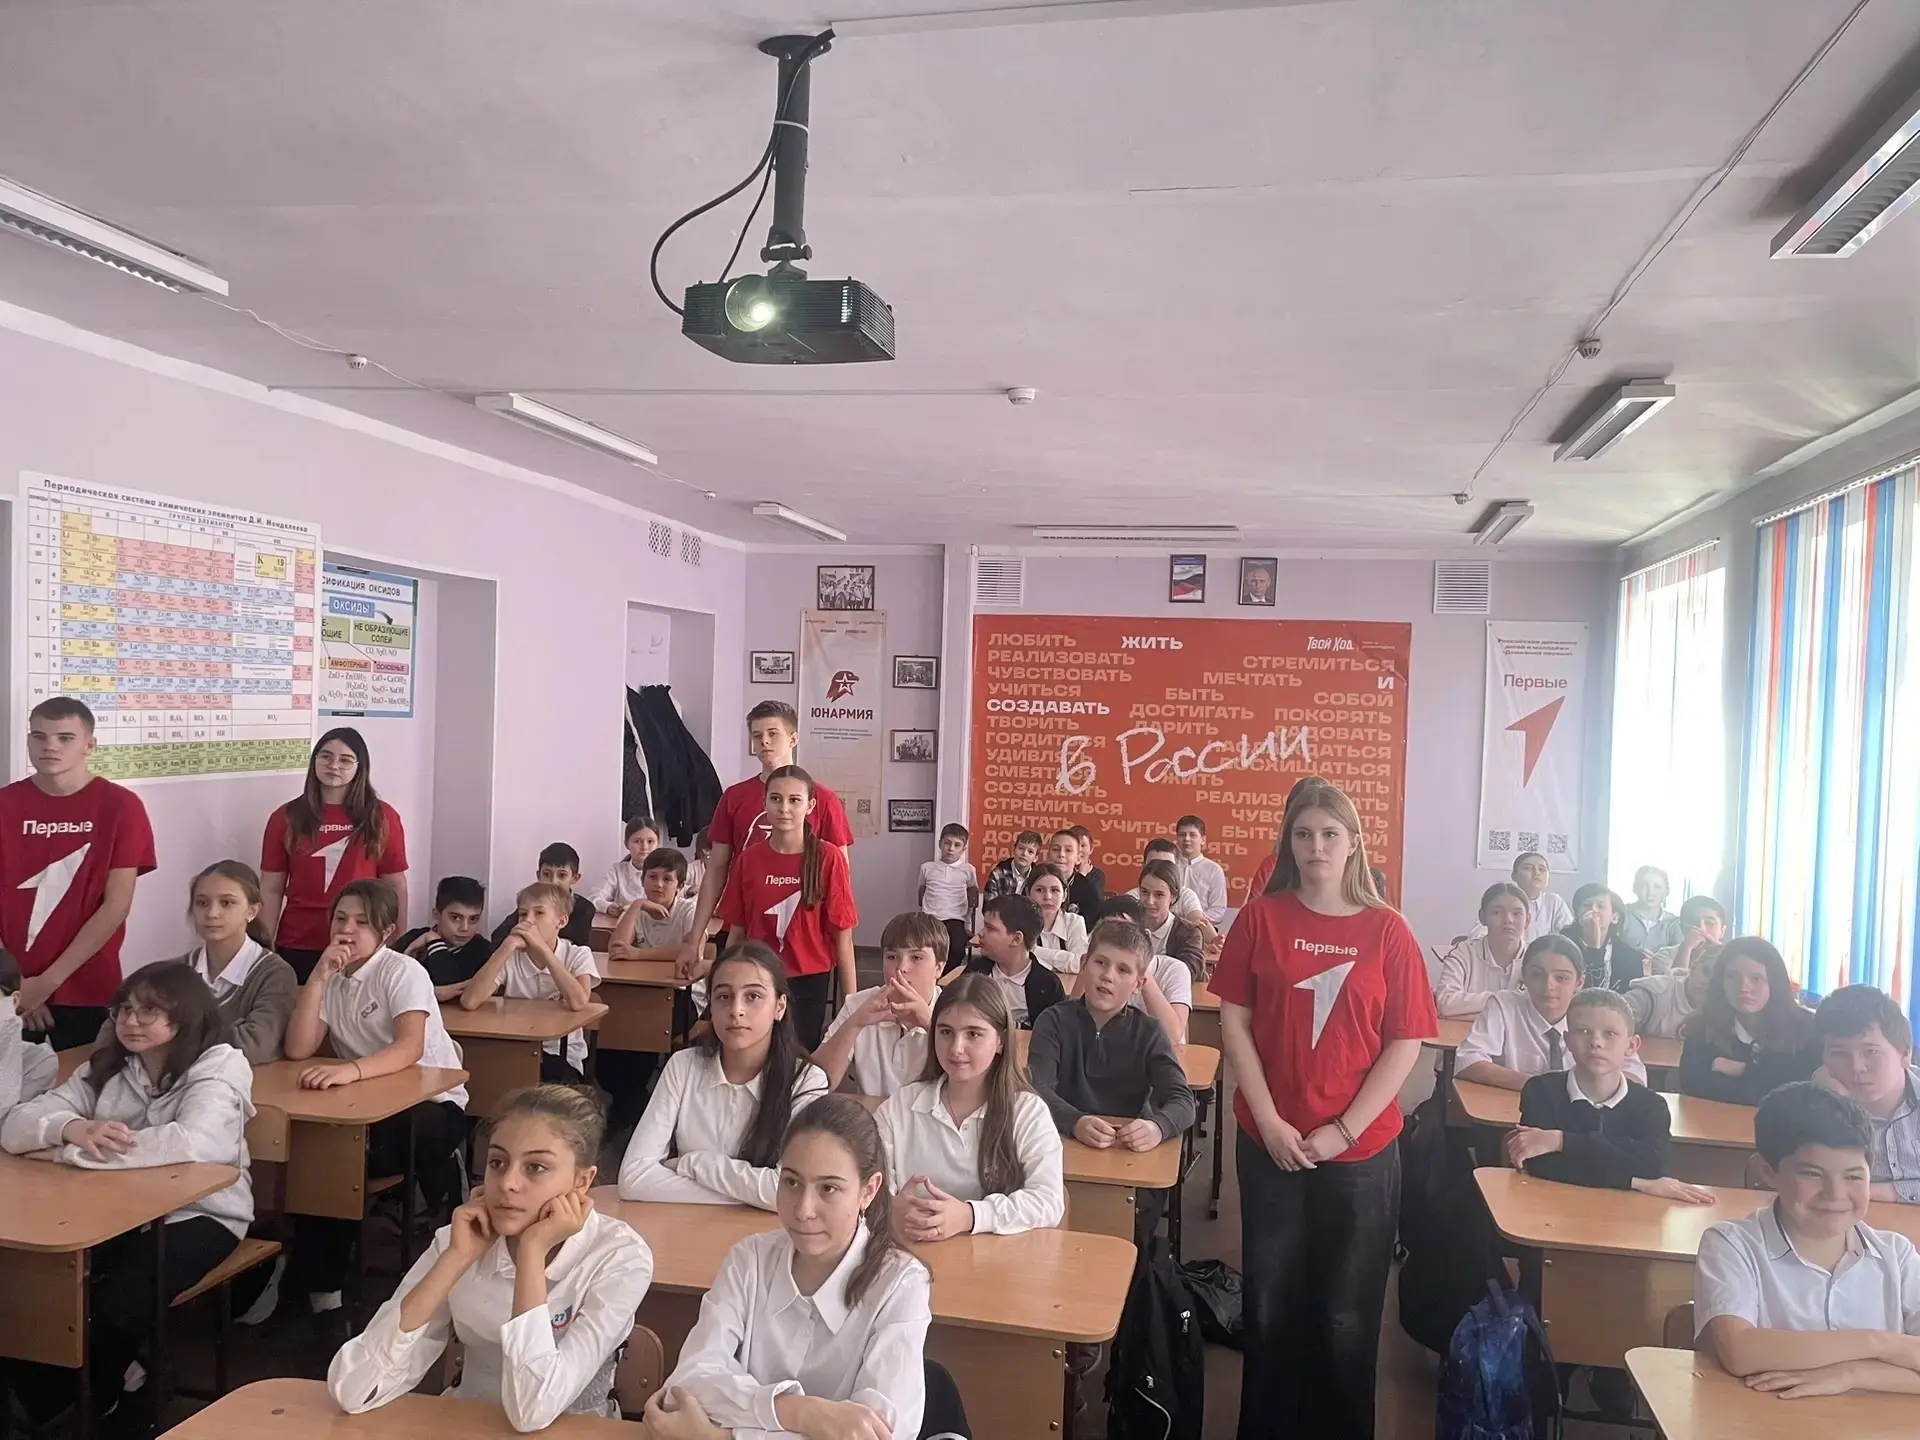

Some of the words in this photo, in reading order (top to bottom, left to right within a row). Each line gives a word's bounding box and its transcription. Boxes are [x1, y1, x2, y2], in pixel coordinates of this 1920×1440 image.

[44, 480, 118, 500] Периодическая
[368, 584, 400, 596] ОКСИДОВ
[333, 600, 370, 614] ОКСИДЫ
[354, 622, 362, 631] НЕ
[364, 624, 408, 636] ОБРАЗУЮЩИЕ
[988, 634, 1077, 647] ЛЮБИТЬ
[1121, 636, 1184, 650] ЖИТЬ
[988, 650, 1136, 665] РЕАЛИЗОВАТЬ
[1242, 656, 1394, 672] СТРЕМИТЬСЯ
[988, 666, 1132, 682] ЧУВСТВОВАТЬ
[1203, 672, 1302, 687] МЕЧТАТЬ
[988, 683, 1081, 697] УЧИТЬСЯ
[1377, 676, 1394, 690] И
[1504, 674, 1568, 692] Первые
[1165, 688, 1224, 702] БЫТЬ
[1313, 690, 1394, 707] СОБОЙ
[810, 708, 874, 720] ЮНАРМИЯ
[986, 699, 1110, 716] СОЗДАВАТЬ
[1128, 704, 1254, 720] ДОСТИГАТЬ
[986, 716, 1080, 730] ТВОРИТЬ
[1274, 708, 1392, 724] ПОКОРЯТЬ
[1116, 726, 1312, 786] России
[984, 798, 1122, 816] СТРЕМИТЬСЯ
[22, 820, 94, 838] Первые
[983, 814, 1076, 830] МЕЧТАТЬ
[1294, 938, 1358, 956] Первые
